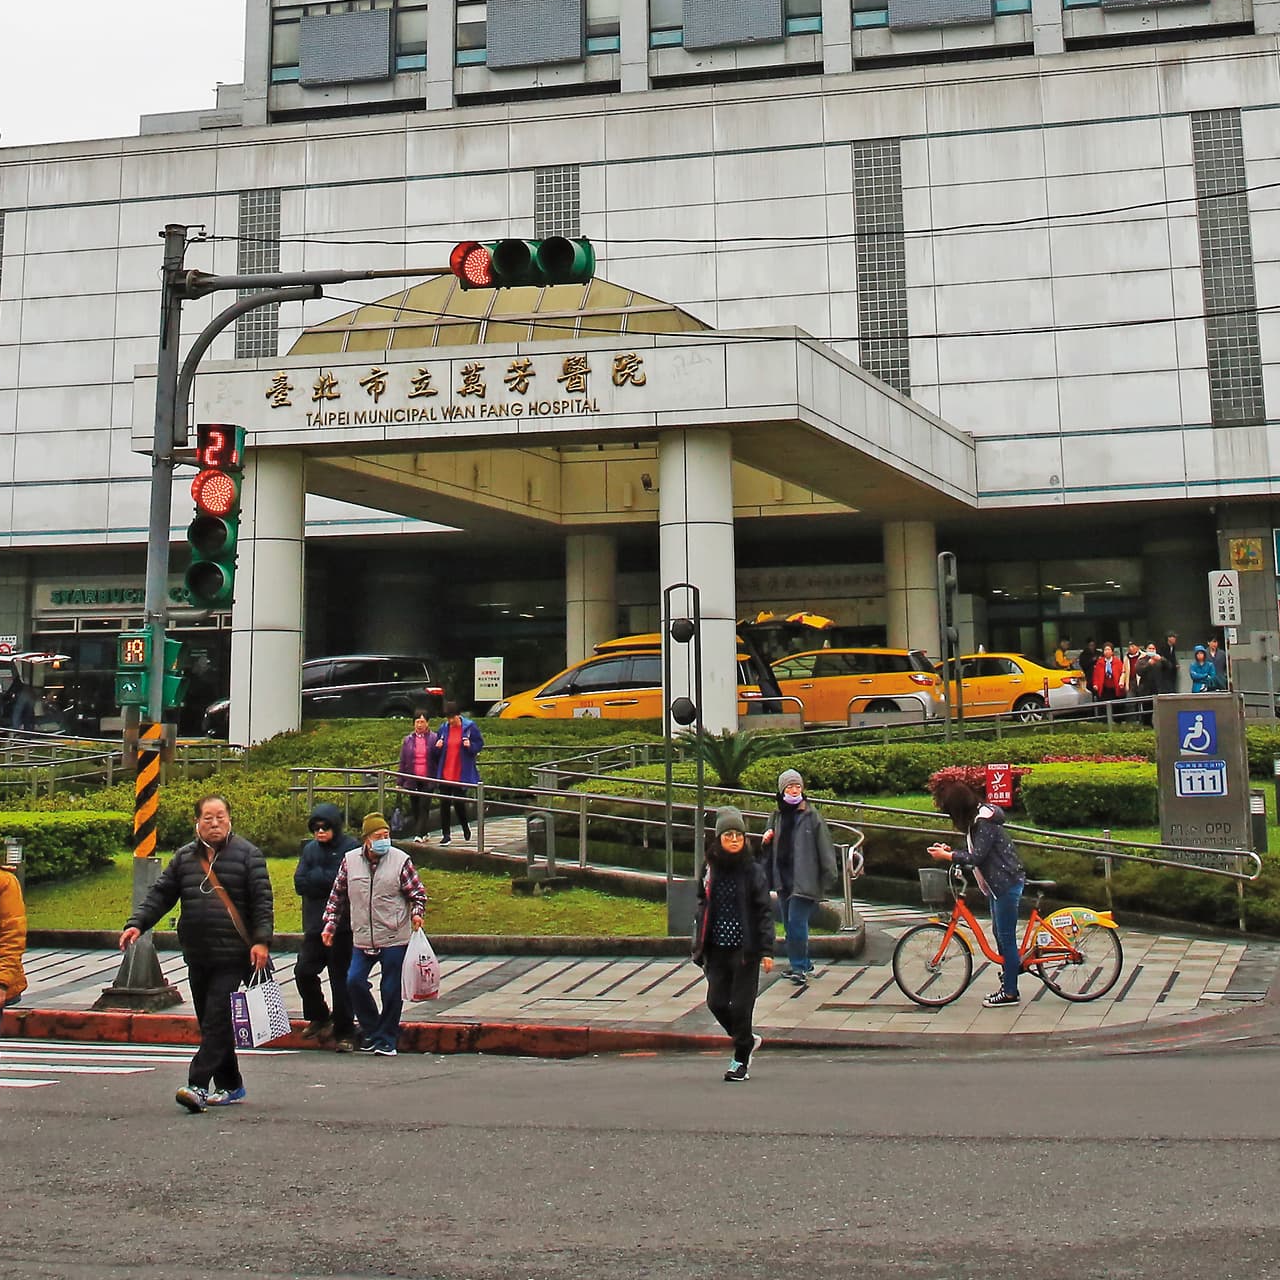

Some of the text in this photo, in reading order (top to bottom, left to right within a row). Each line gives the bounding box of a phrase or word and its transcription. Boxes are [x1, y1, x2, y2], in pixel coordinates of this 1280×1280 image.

[265, 352, 647, 409] 臺北市立萬芳醫院
[305, 398, 600, 427] TAIPEI MUNICIPAL WAN FANG HOSPITAL
[51, 588, 145, 604] STARBUC
[1186, 775, 1217, 791] 111
